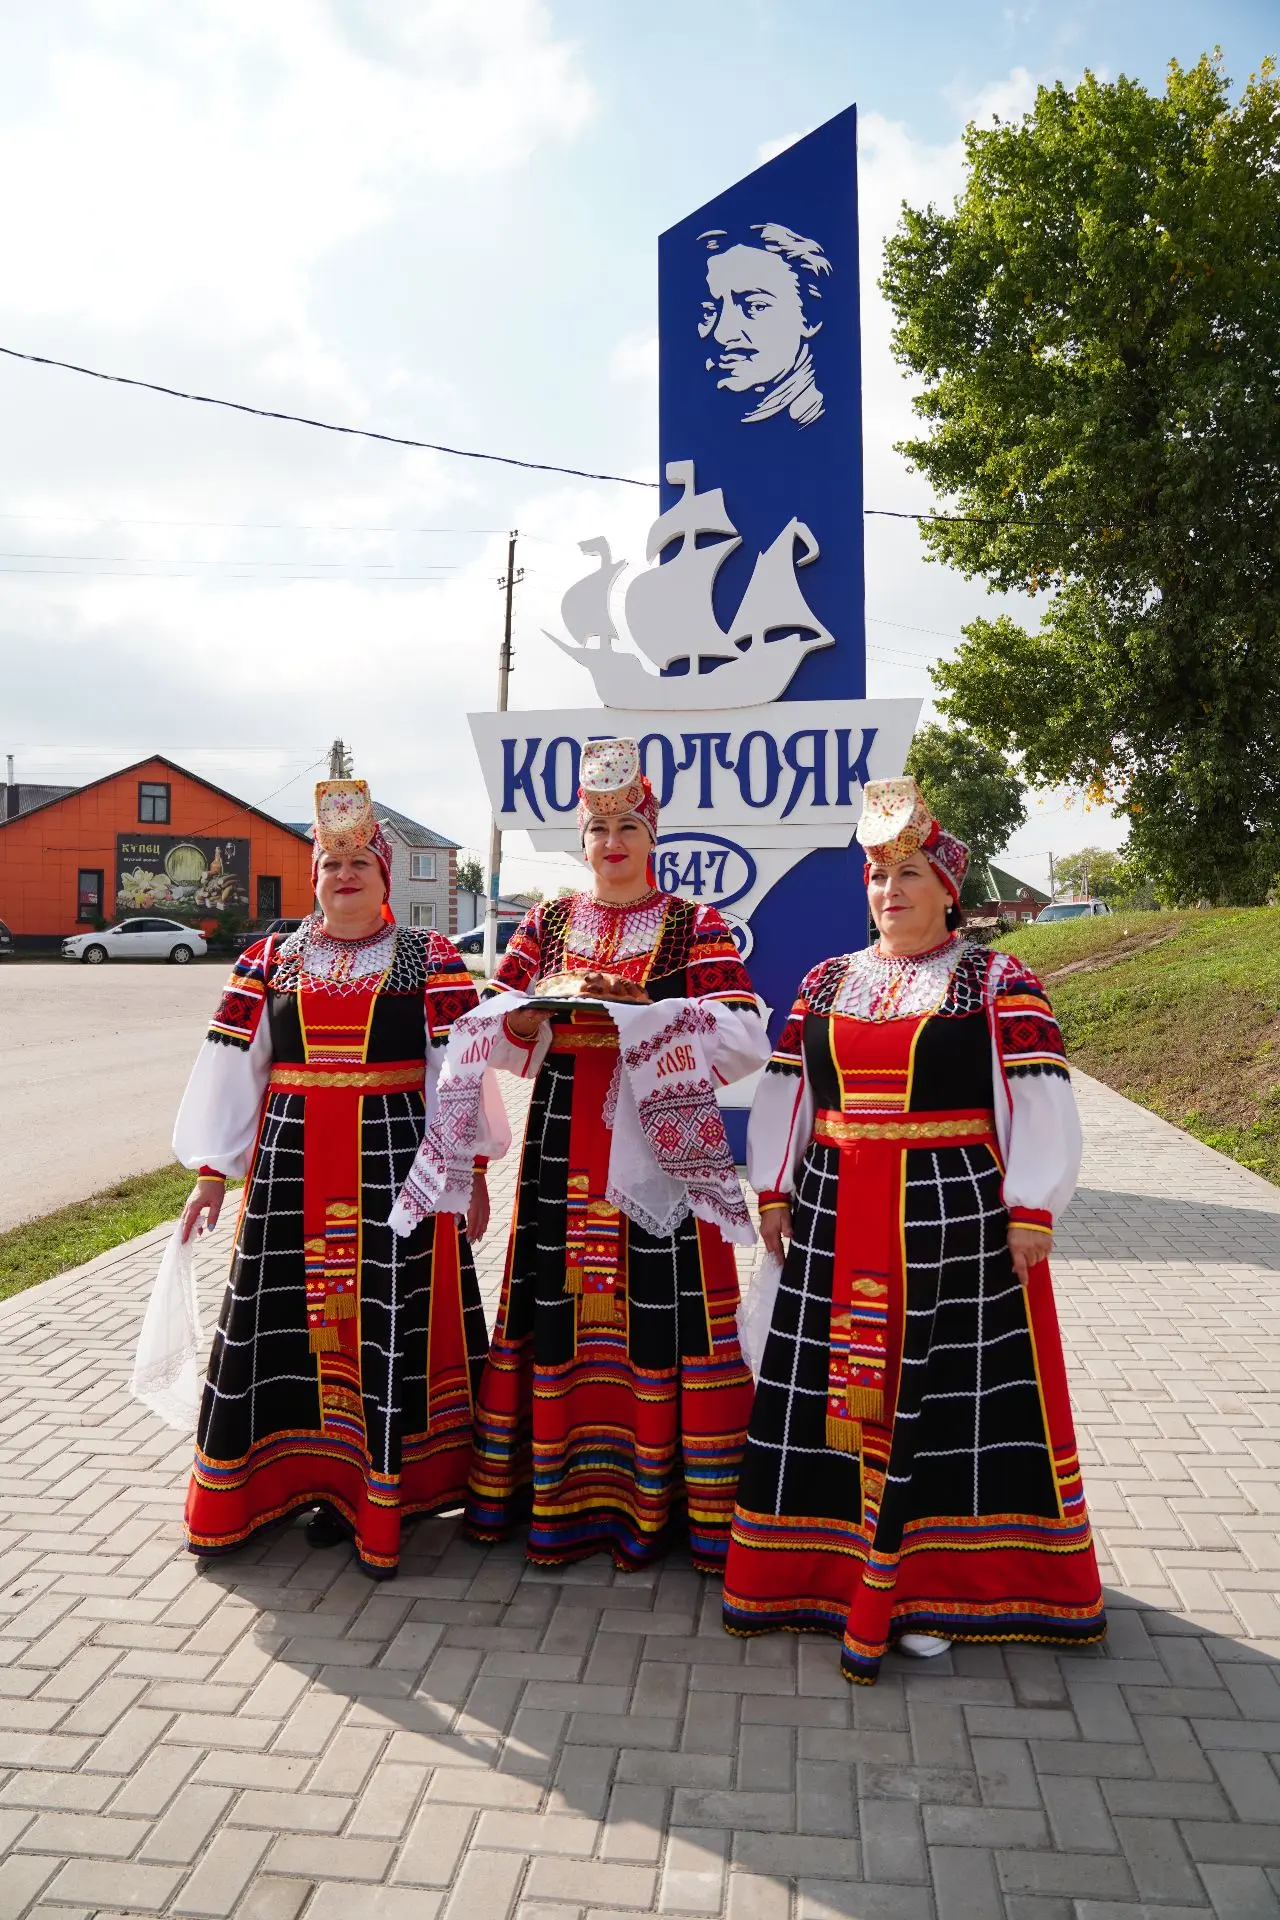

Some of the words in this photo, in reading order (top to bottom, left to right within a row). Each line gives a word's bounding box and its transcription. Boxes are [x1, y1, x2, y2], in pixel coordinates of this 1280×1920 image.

[501, 728, 878, 822] КООТОЯК
[121, 844, 160, 856] КУПЕЦ
[656, 1044, 696, 1078] ХЛЕБ
